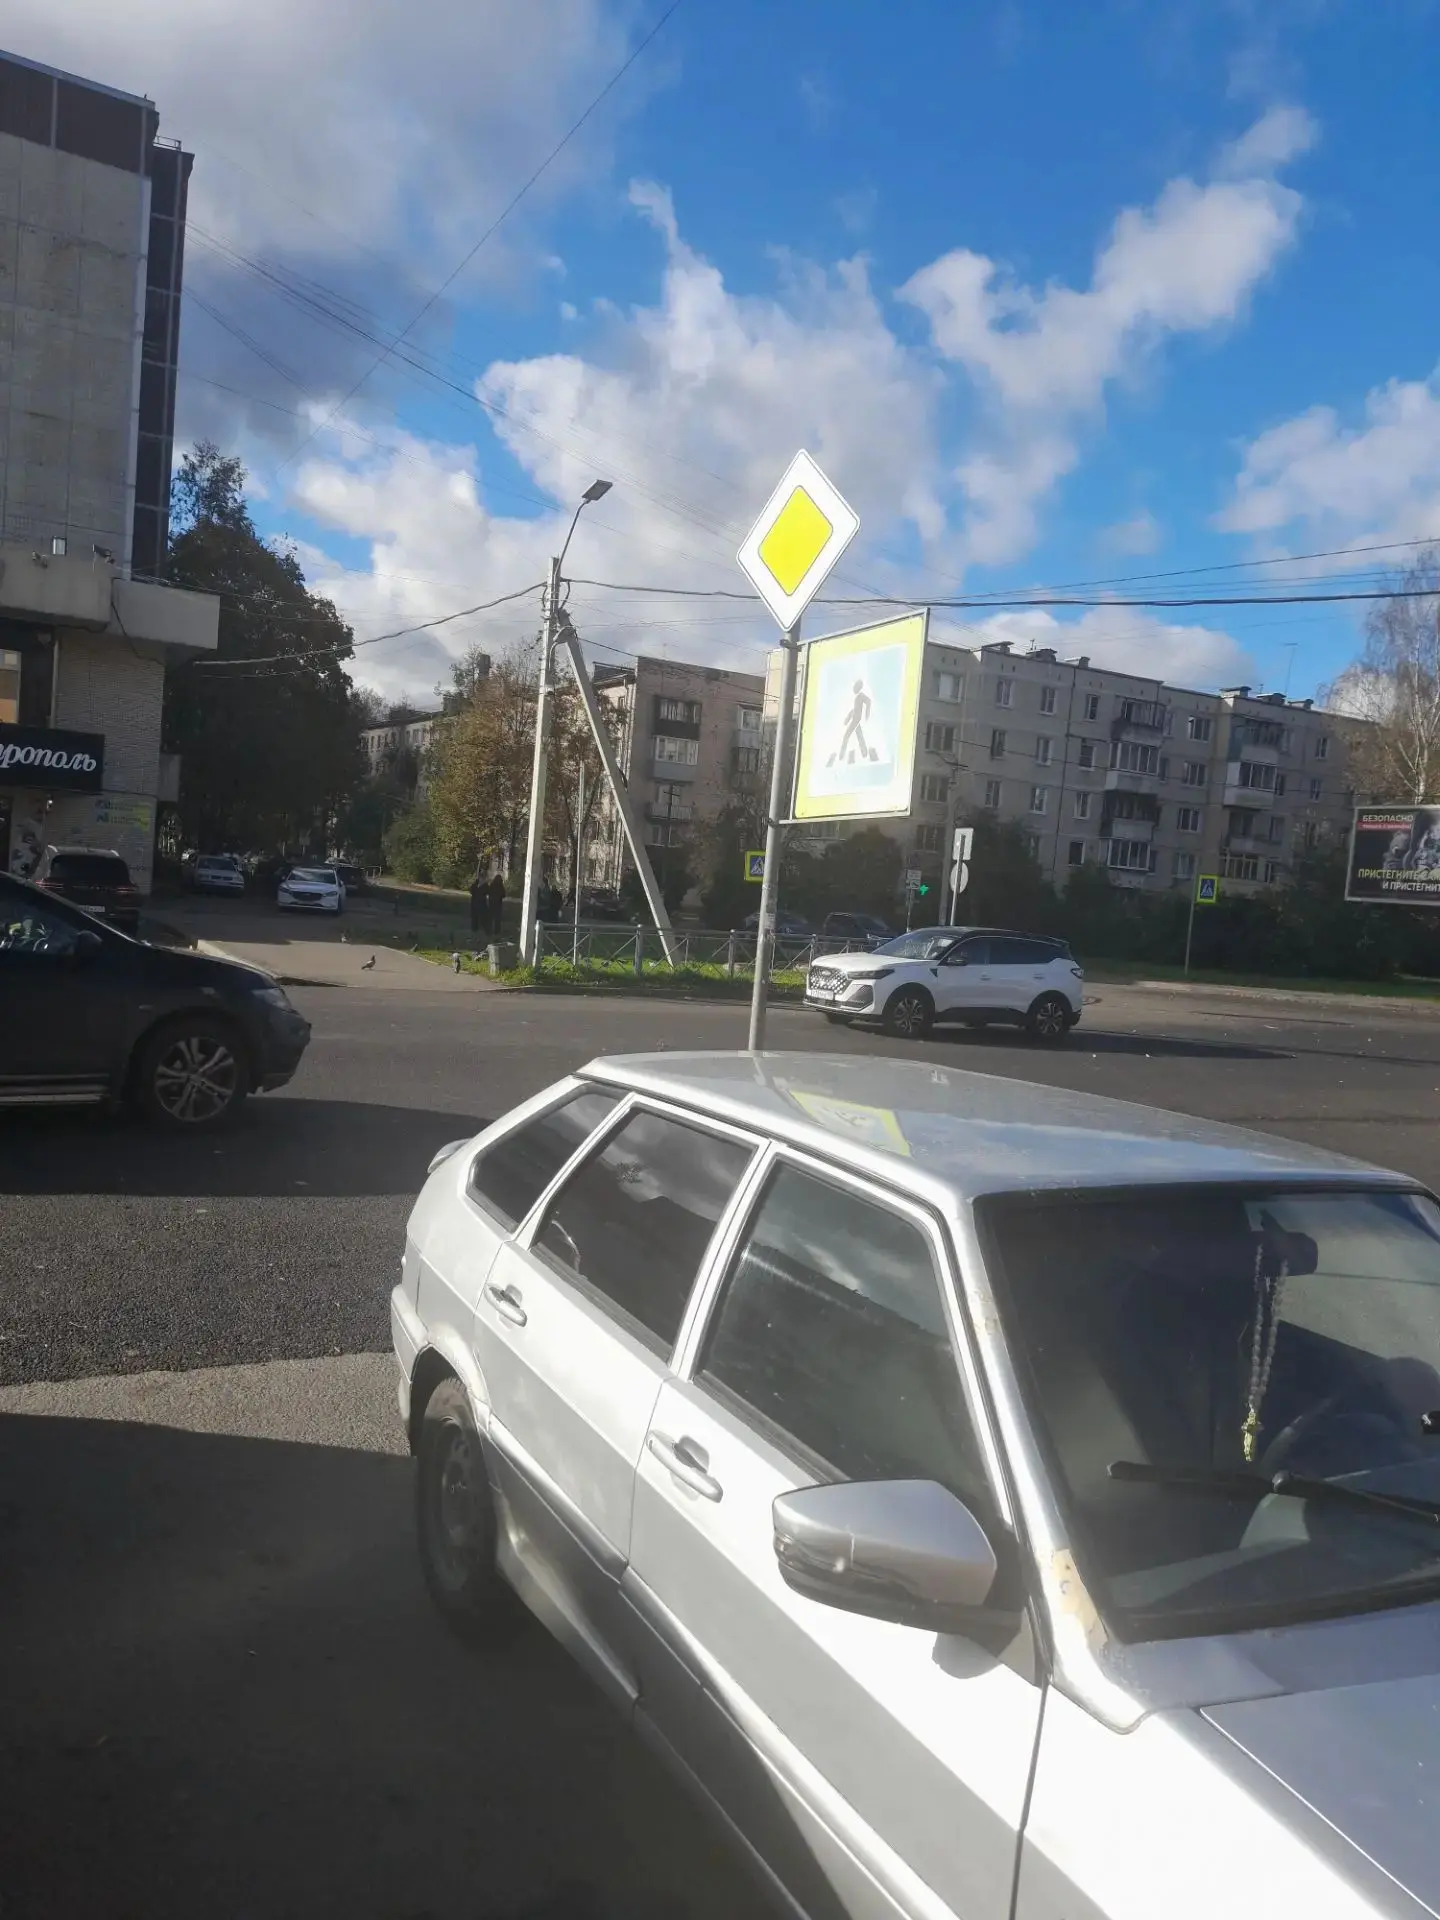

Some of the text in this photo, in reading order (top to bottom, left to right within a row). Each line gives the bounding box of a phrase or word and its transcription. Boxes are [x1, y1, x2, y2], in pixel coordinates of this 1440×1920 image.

[1362, 814, 1414, 822] БЕЗОПАСНО
[1358, 868, 1418, 881] ПРИСТЕГНИТЕ
[1382, 881, 1389, 889] И
